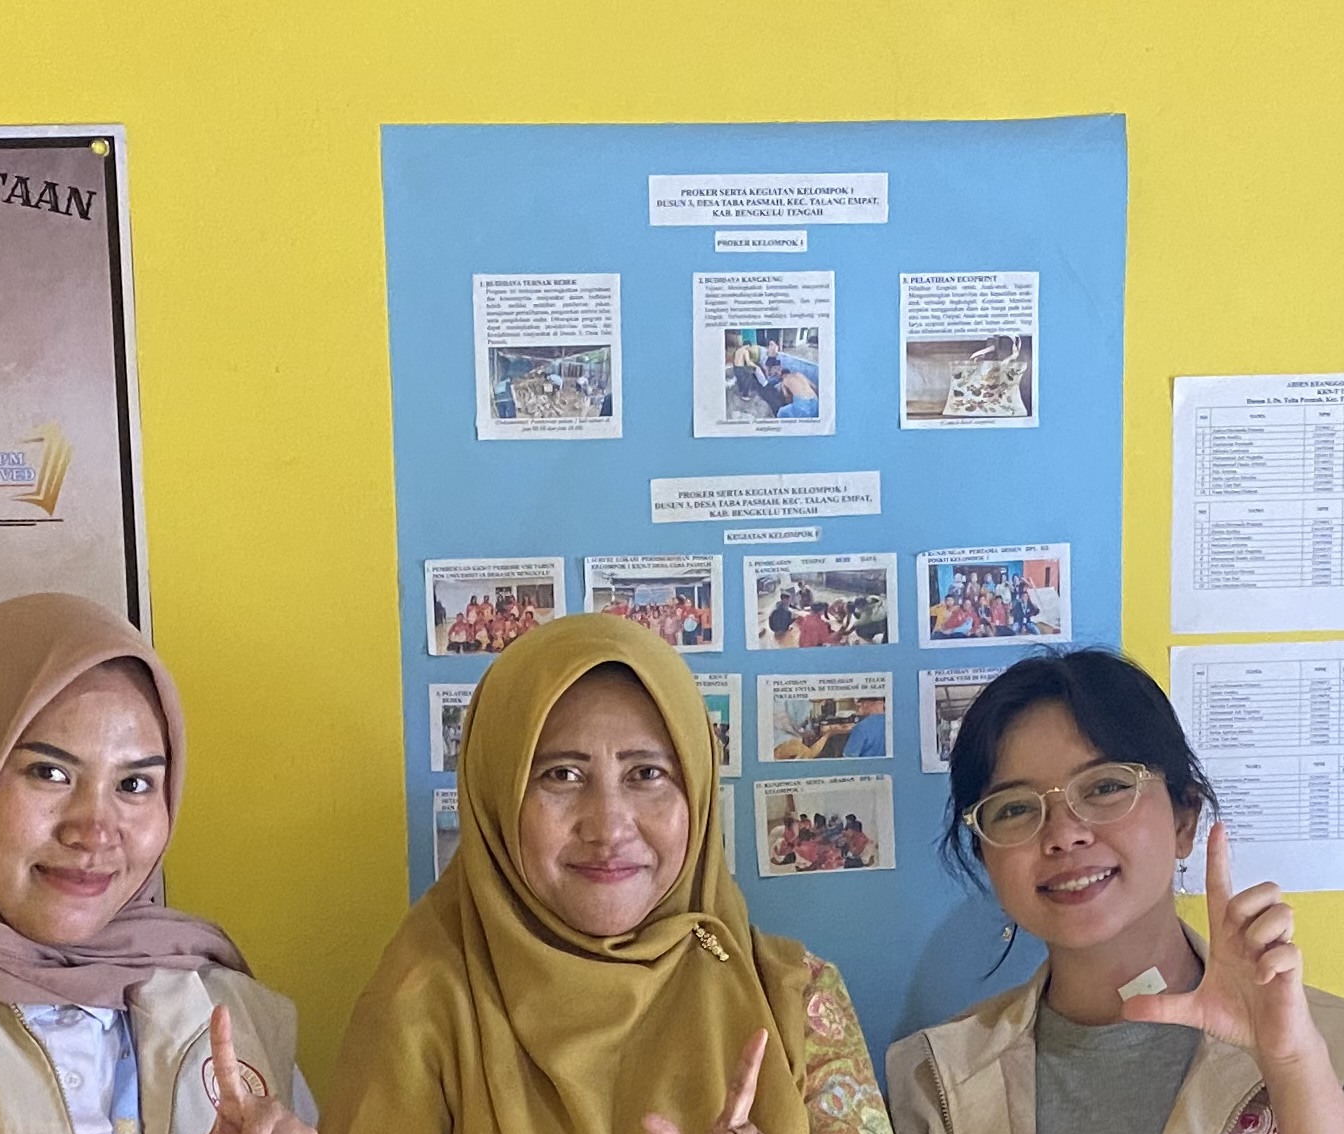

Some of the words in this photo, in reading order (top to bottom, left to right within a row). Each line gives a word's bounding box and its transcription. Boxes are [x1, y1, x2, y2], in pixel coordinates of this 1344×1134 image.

[680, 189, 718, 197] PROKER
[719, 188, 748, 196] SERTA
[749, 187, 795, 196] KEGIATAN
[797, 187, 849, 195] KELOMPOK
[657, 199, 687, 207] DUSUN
[697, 199, 720, 207] DESA
[722, 199, 745, 207] TABA
[809, 197, 846, 206] TALANG
[734, 208, 784, 217] BENGKULU
[786, 208, 823, 216] TENGAH
[717, 239, 750, 247] PROKER
[751, 239, 798, 247] KELOMPOK
[678, 491, 715, 499] PROKER
[716, 489, 743, 498] SERTA
[745, 488, 790, 497] KEGIATAN
[791, 486, 842, 495] KELOMPOK
[694, 500, 717, 508] DESA
[719, 499, 741, 508] TABA
[731, 508, 780, 517] BENGKULU
[782, 506, 818, 515] TENGAH
[727, 532, 767, 541] KEGIATAN
[768, 531, 813, 539] KELOMPOK
